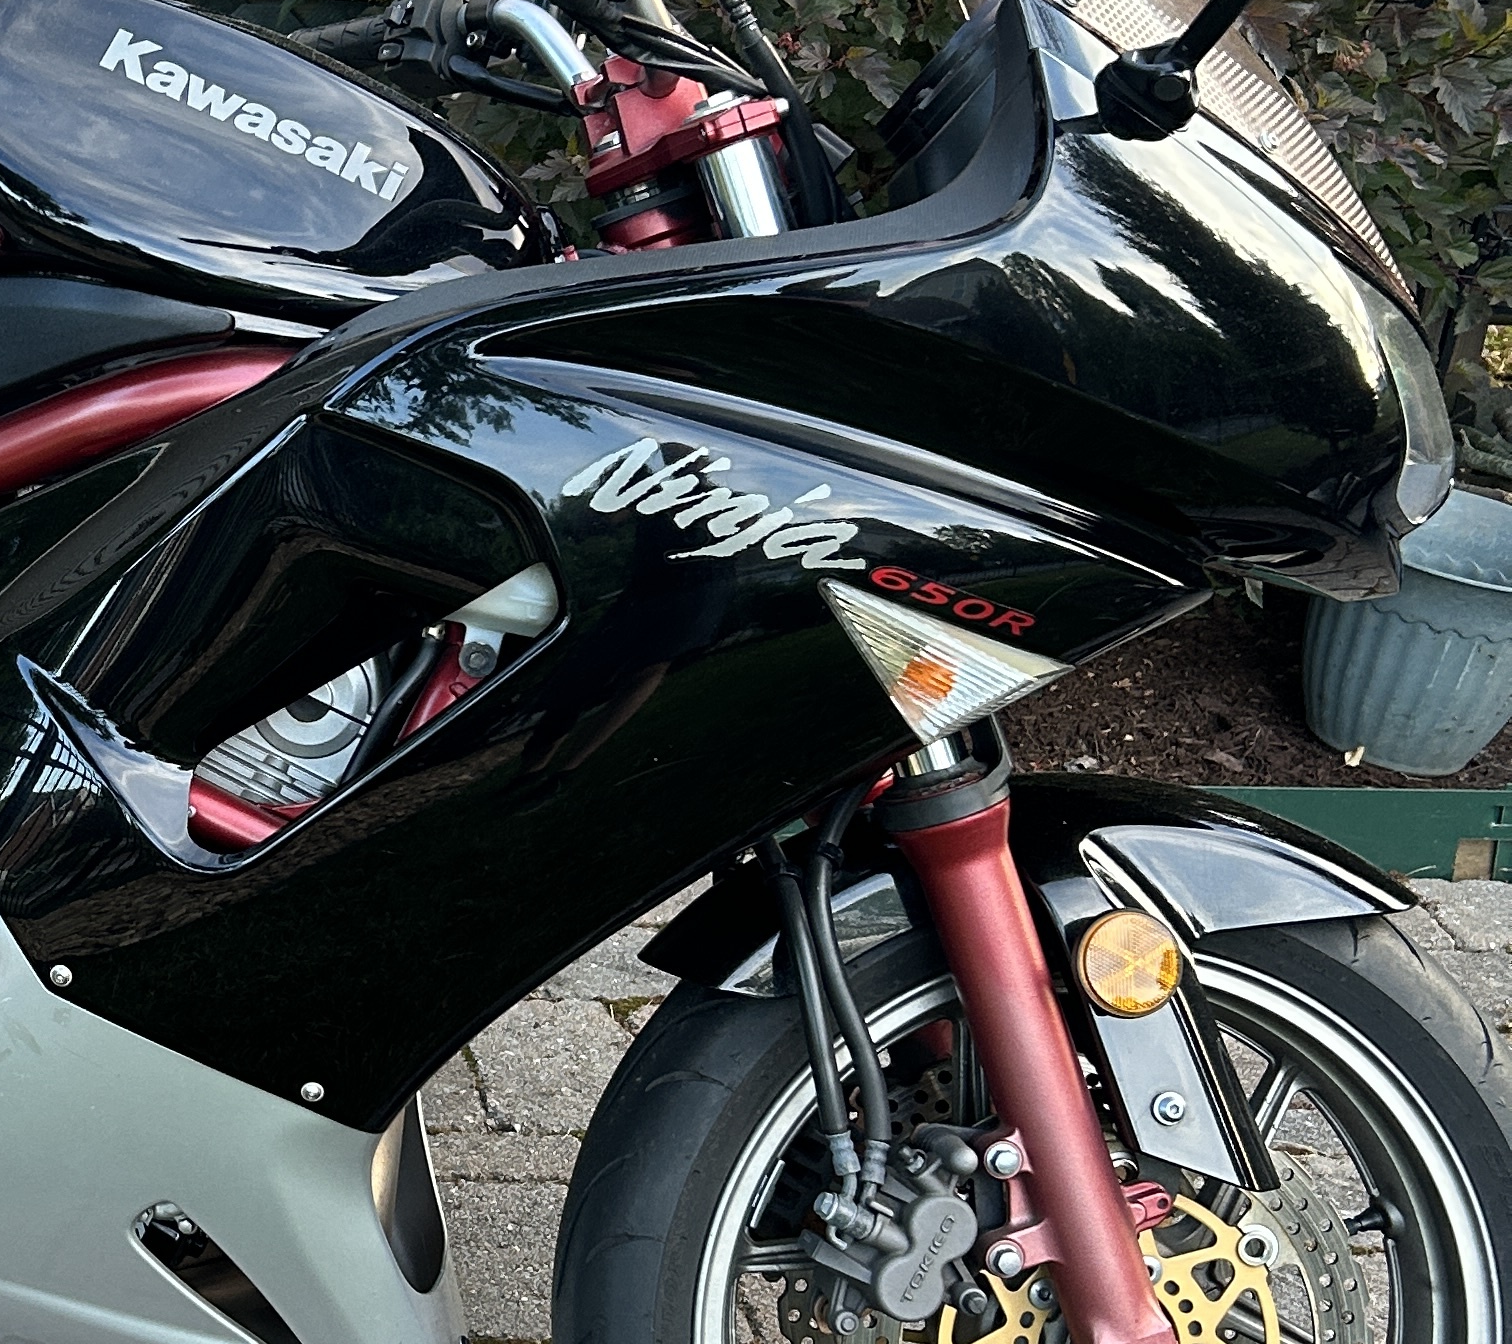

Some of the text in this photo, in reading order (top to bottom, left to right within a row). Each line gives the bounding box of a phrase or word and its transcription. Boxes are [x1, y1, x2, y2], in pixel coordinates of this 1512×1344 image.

[99, 28, 410, 202] Kawasaki
[562, 437, 1036, 636] Ninja 650R
